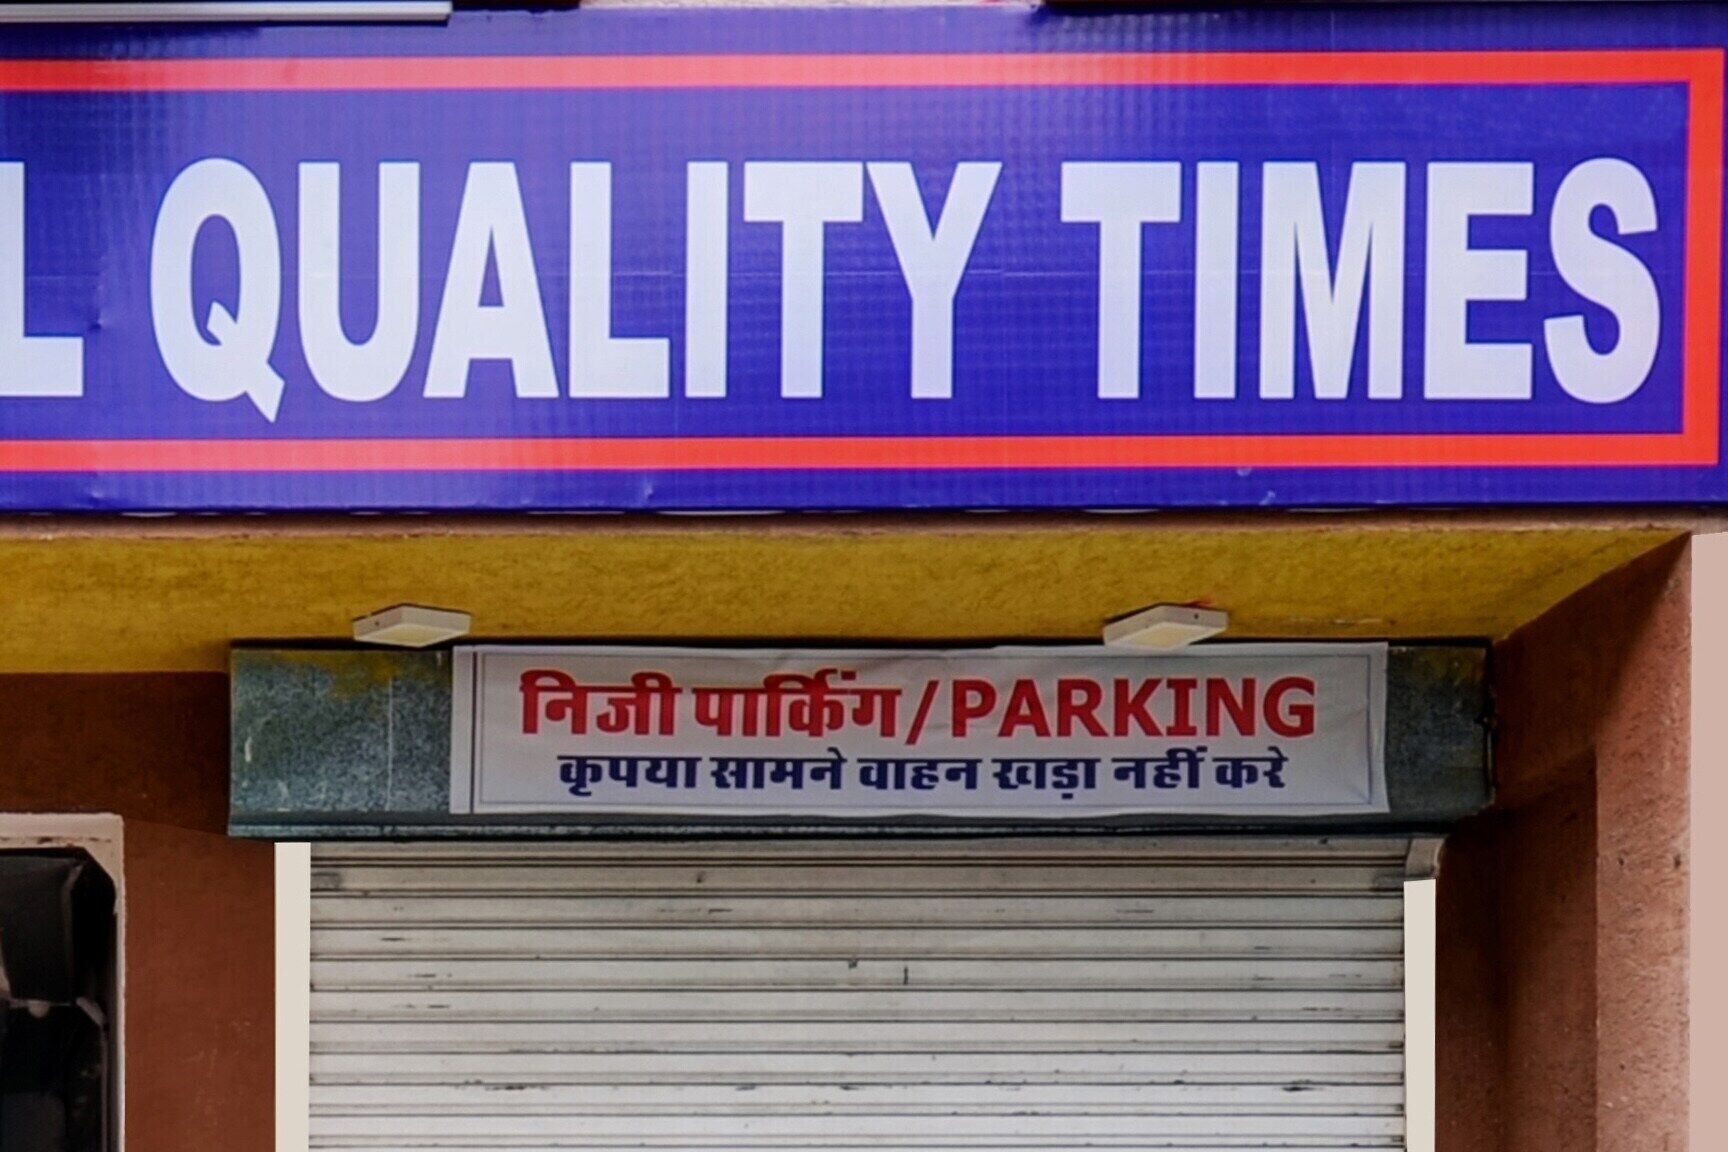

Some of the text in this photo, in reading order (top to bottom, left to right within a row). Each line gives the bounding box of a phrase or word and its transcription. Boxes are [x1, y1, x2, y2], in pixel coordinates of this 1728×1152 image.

[150, 157, 1003, 423] QUALITY
[1060, 157, 1661, 403] TIMES
[520, 669, 683, 736] निजी
[951, 676, 1316, 738] PARKING
[556, 754, 703, 797] कृपया
[708, 746, 848, 791] सामने
[856, 757, 983, 791] वाहन
[1110, 745, 1209, 790] नहीं
[1211, 745, 1289, 790] करे
